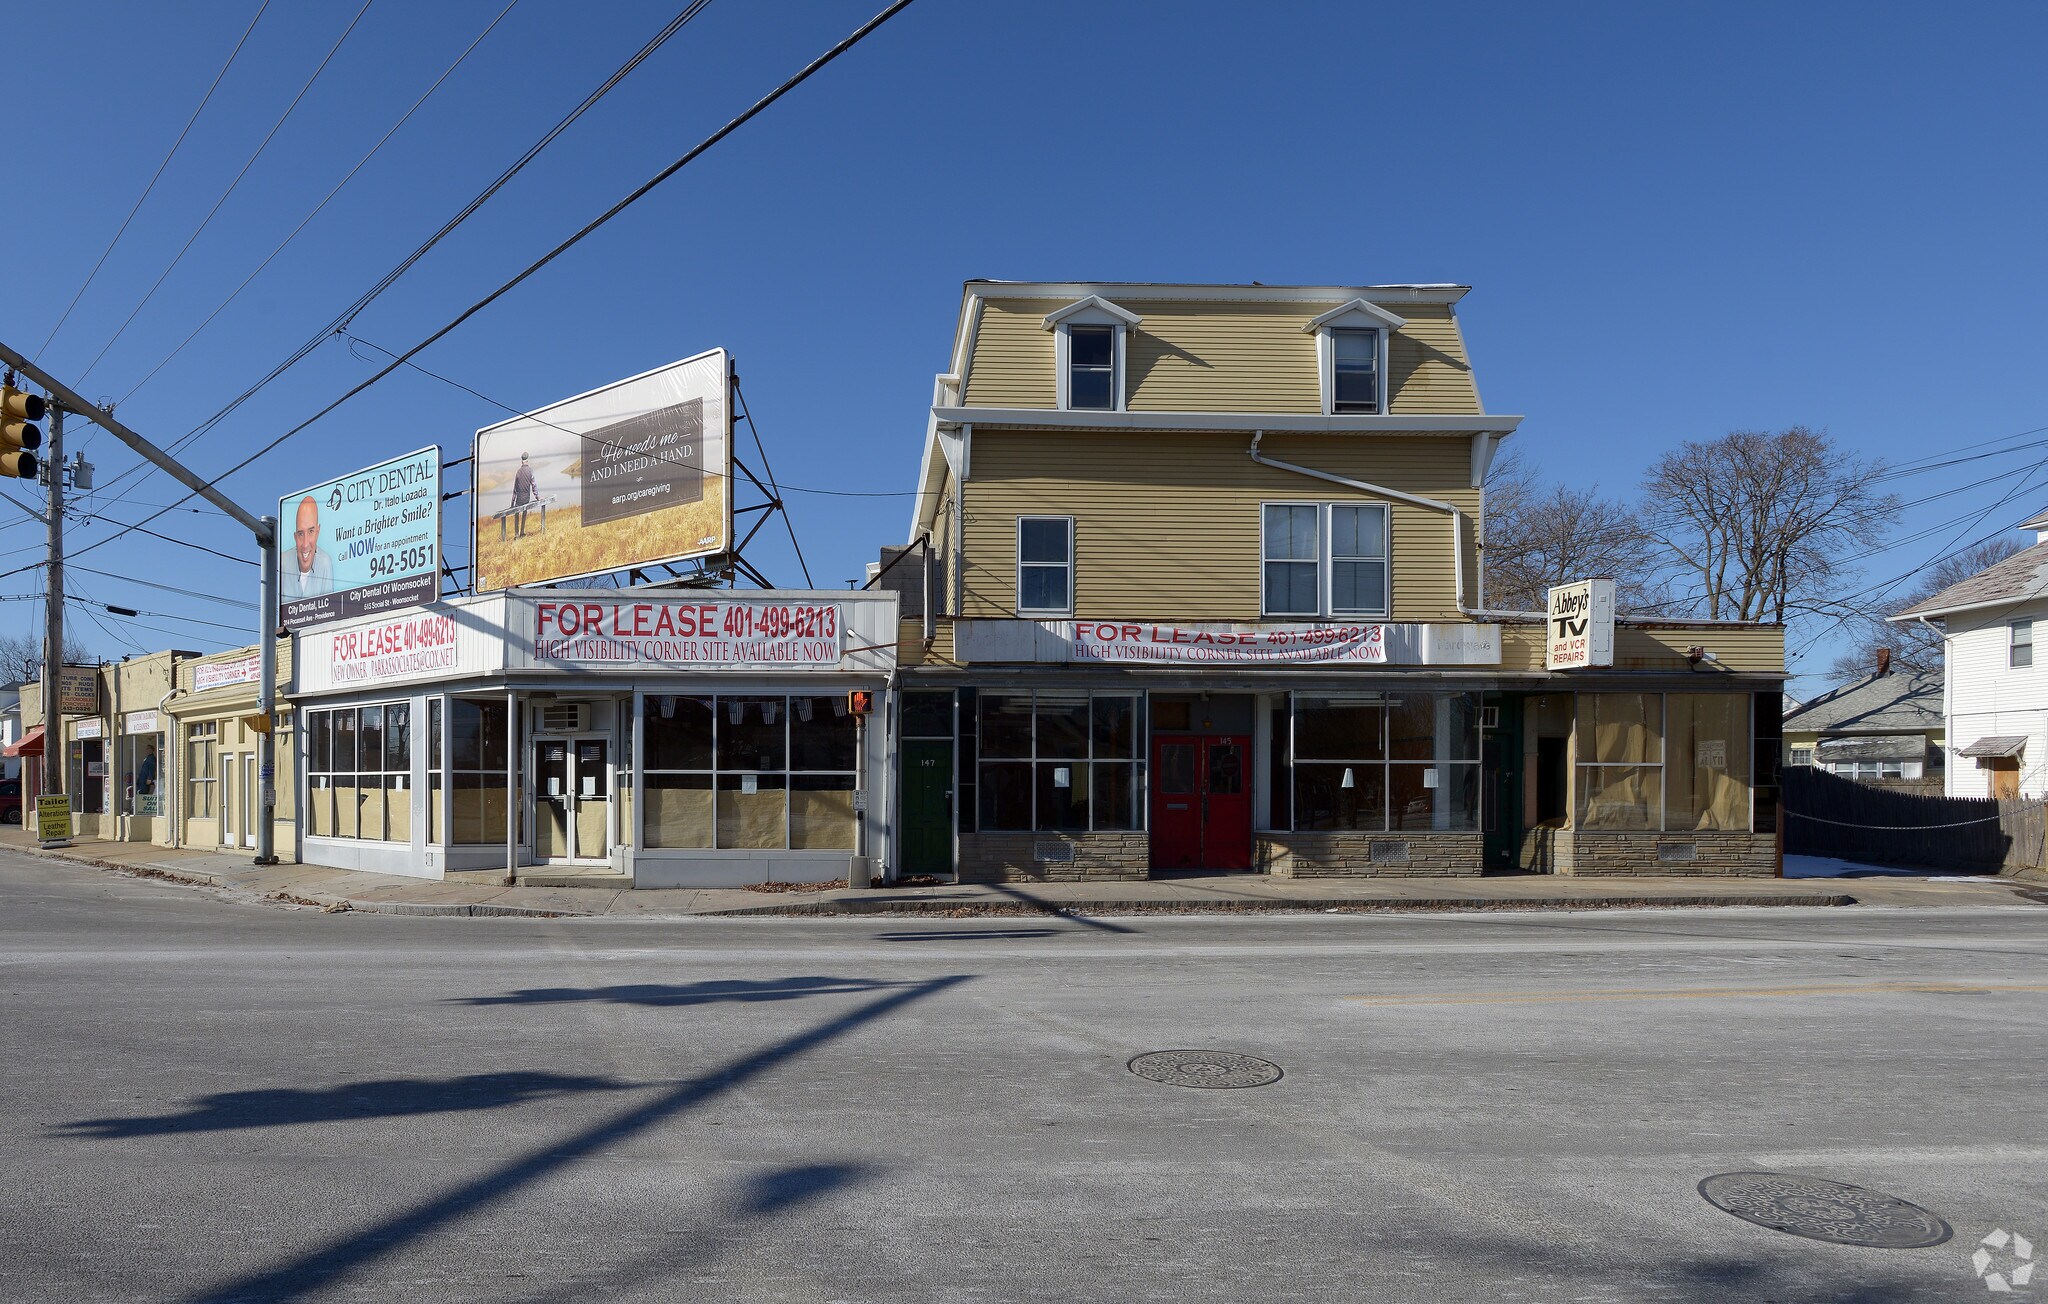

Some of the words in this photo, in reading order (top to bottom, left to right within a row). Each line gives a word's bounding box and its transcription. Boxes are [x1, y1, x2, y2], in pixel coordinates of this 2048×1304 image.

[601, 436, 624, 463] He
[624, 434, 658, 456] needs
[660, 432, 679, 446] me
[590, 466, 612, 483] AND
[614, 464, 619, 476] I
[620, 456, 648, 475] NEED
[650, 454, 658, 467] A
[660, 444, 694, 464] HAND.
[347, 476, 376, 503] CITY
[379, 459, 434, 493] DENTAL
[374, 500, 383, 511] Dr.
[385, 496, 400, 508] Italo
[402, 486, 427, 503] Lozada
[611, 483, 671, 504] aarp.org/caregiving
[335, 526, 355, 542] Want
[357, 526, 363, 536] a
[365, 515, 399, 534] Brighter
[401, 501, 433, 524] Smile?
[338, 551, 348, 562] Call
[349, 537, 376, 559] NOW
[375, 543, 383, 552] for
[383, 542, 391, 550] an
[391, 532, 428, 549] appointment
[370, 543, 434, 578] 942-5051
[350, 590, 361, 602] City
[362, 586, 382, 598] Dental
[382, 583, 391, 594] Of
[391, 575, 432, 592] Woonsocket
[288, 605, 298, 615] City
[299, 601, 317, 613] Dental,
[318, 598, 329, 608] LLC
[371, 599, 384, 609] Social
[384, 598, 390, 606] St
[392, 594, 419, 605] Woonsocket
[1552, 588, 1590, 619] Abbey's
[315, 611, 336, 620] Providence
[537, 603, 604, 636] FOR
[613, 604, 718, 638] LEASE
[723, 606, 836, 638] 401-499-6213
[333, 633, 357, 663] FOR
[360, 624, 403, 658] LEASE
[404, 613, 455, 651] 401-499-6213
[1075, 623, 1142, 643] FOR
[1151, 626, 1258, 645] LEASE
[1267, 625, 1382, 645] 401-499-6213
[1552, 616, 1588, 639] TV
[534, 639, 570, 659] HIGH
[574, 640, 641, 660] VISIBILITY
[644, 641, 699, 661] CORNER
[702, 641, 729, 661] SITE
[732, 641, 798, 661] AVAILABLE
[803, 642, 836, 661] NOW
[1075, 644, 1111, 658] HIGH
[1115, 645, 1183, 660] VISIBILITY
[1187, 647, 1243, 661] CORNER
[1247, 648, 1273, 661] SITE
[1276, 648, 1344, 661] AVAILABLE
[1348, 645, 1382, 659] NOW
[1554, 642, 1567, 652] and
[1570, 639, 1586, 650] VCR
[333, 664, 346, 681] NEW
[347, 661, 368, 680] OWNER
[371, 647, 454, 676] PARKASSOCIATES@COX.NET
[1553, 651, 1585, 664] REPAIRS
[224, 669, 241, 680] CORNER
[1220, 737, 1232, 745] 145
[921, 759, 935, 767] 147
[38, 798, 69, 806] Tailor
[39, 810, 71, 818] Alterations
[44, 822, 67, 830] Leather
[45, 829, 66, 837] Repair
